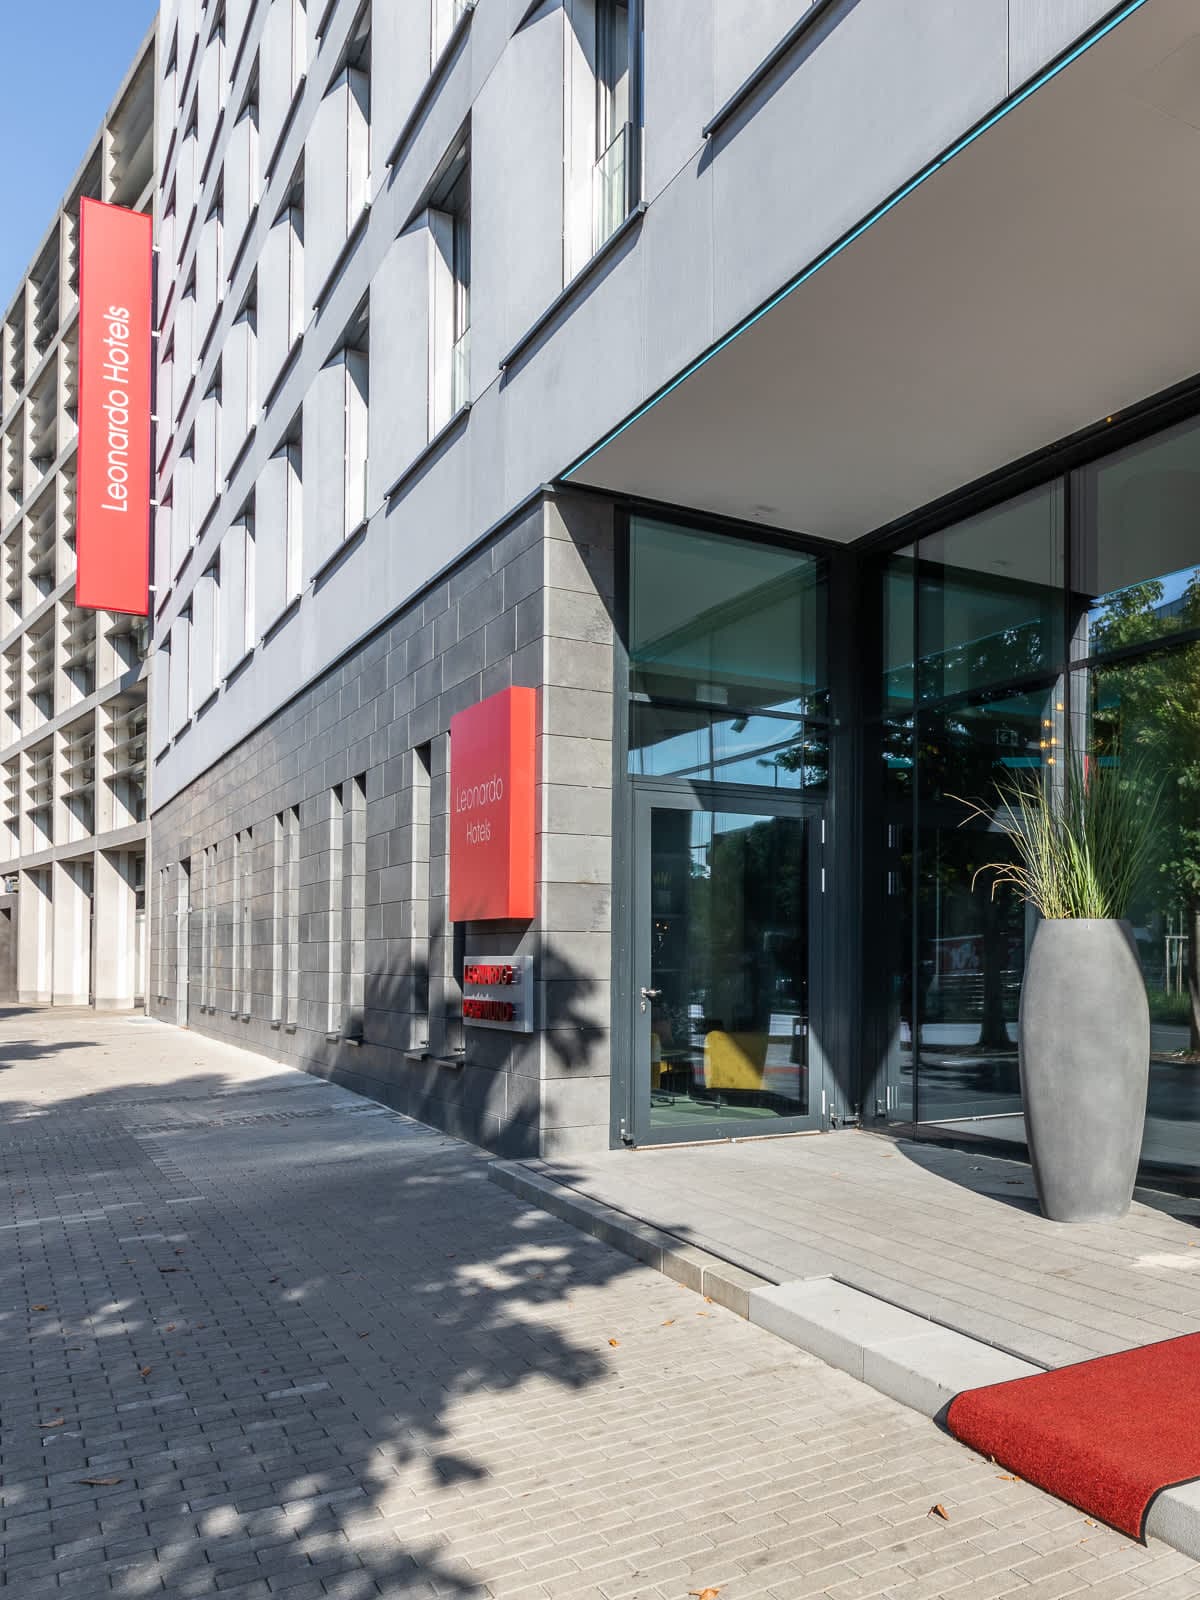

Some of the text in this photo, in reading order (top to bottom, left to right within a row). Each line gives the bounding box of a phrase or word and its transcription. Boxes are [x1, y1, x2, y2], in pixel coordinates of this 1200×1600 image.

[101, 305, 130, 512] Leonardo Hotels
[456, 775, 504, 813] Leonardo
[466, 819, 491, 844] Hotels
